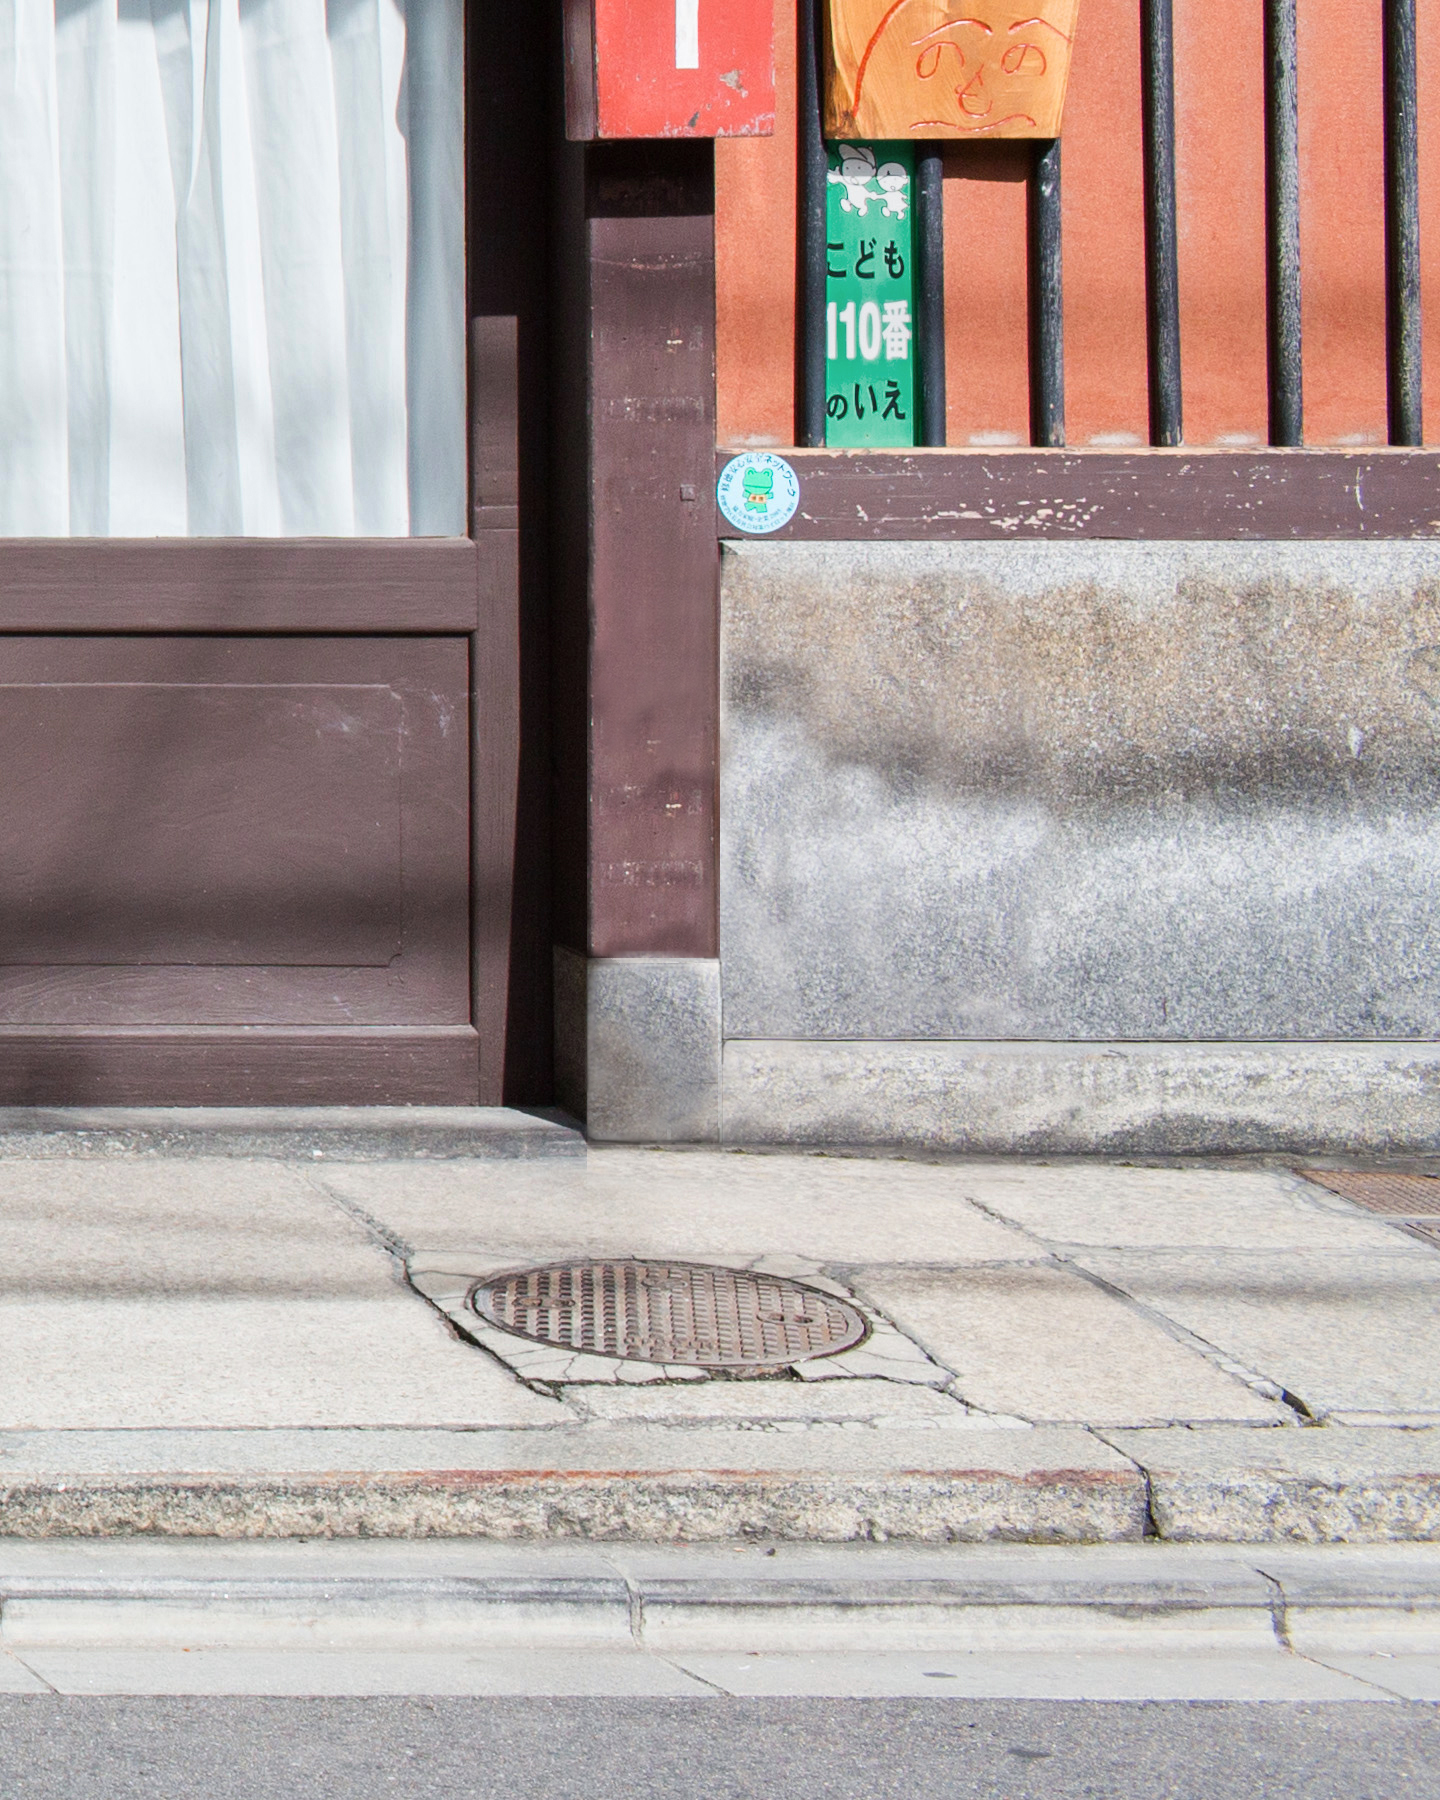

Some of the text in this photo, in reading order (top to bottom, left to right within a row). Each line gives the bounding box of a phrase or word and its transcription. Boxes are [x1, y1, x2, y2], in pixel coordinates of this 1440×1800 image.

[826, 237, 905, 279] こども
[827, 300, 912, 361] 110番
[827, 380, 906, 421] のいえ
